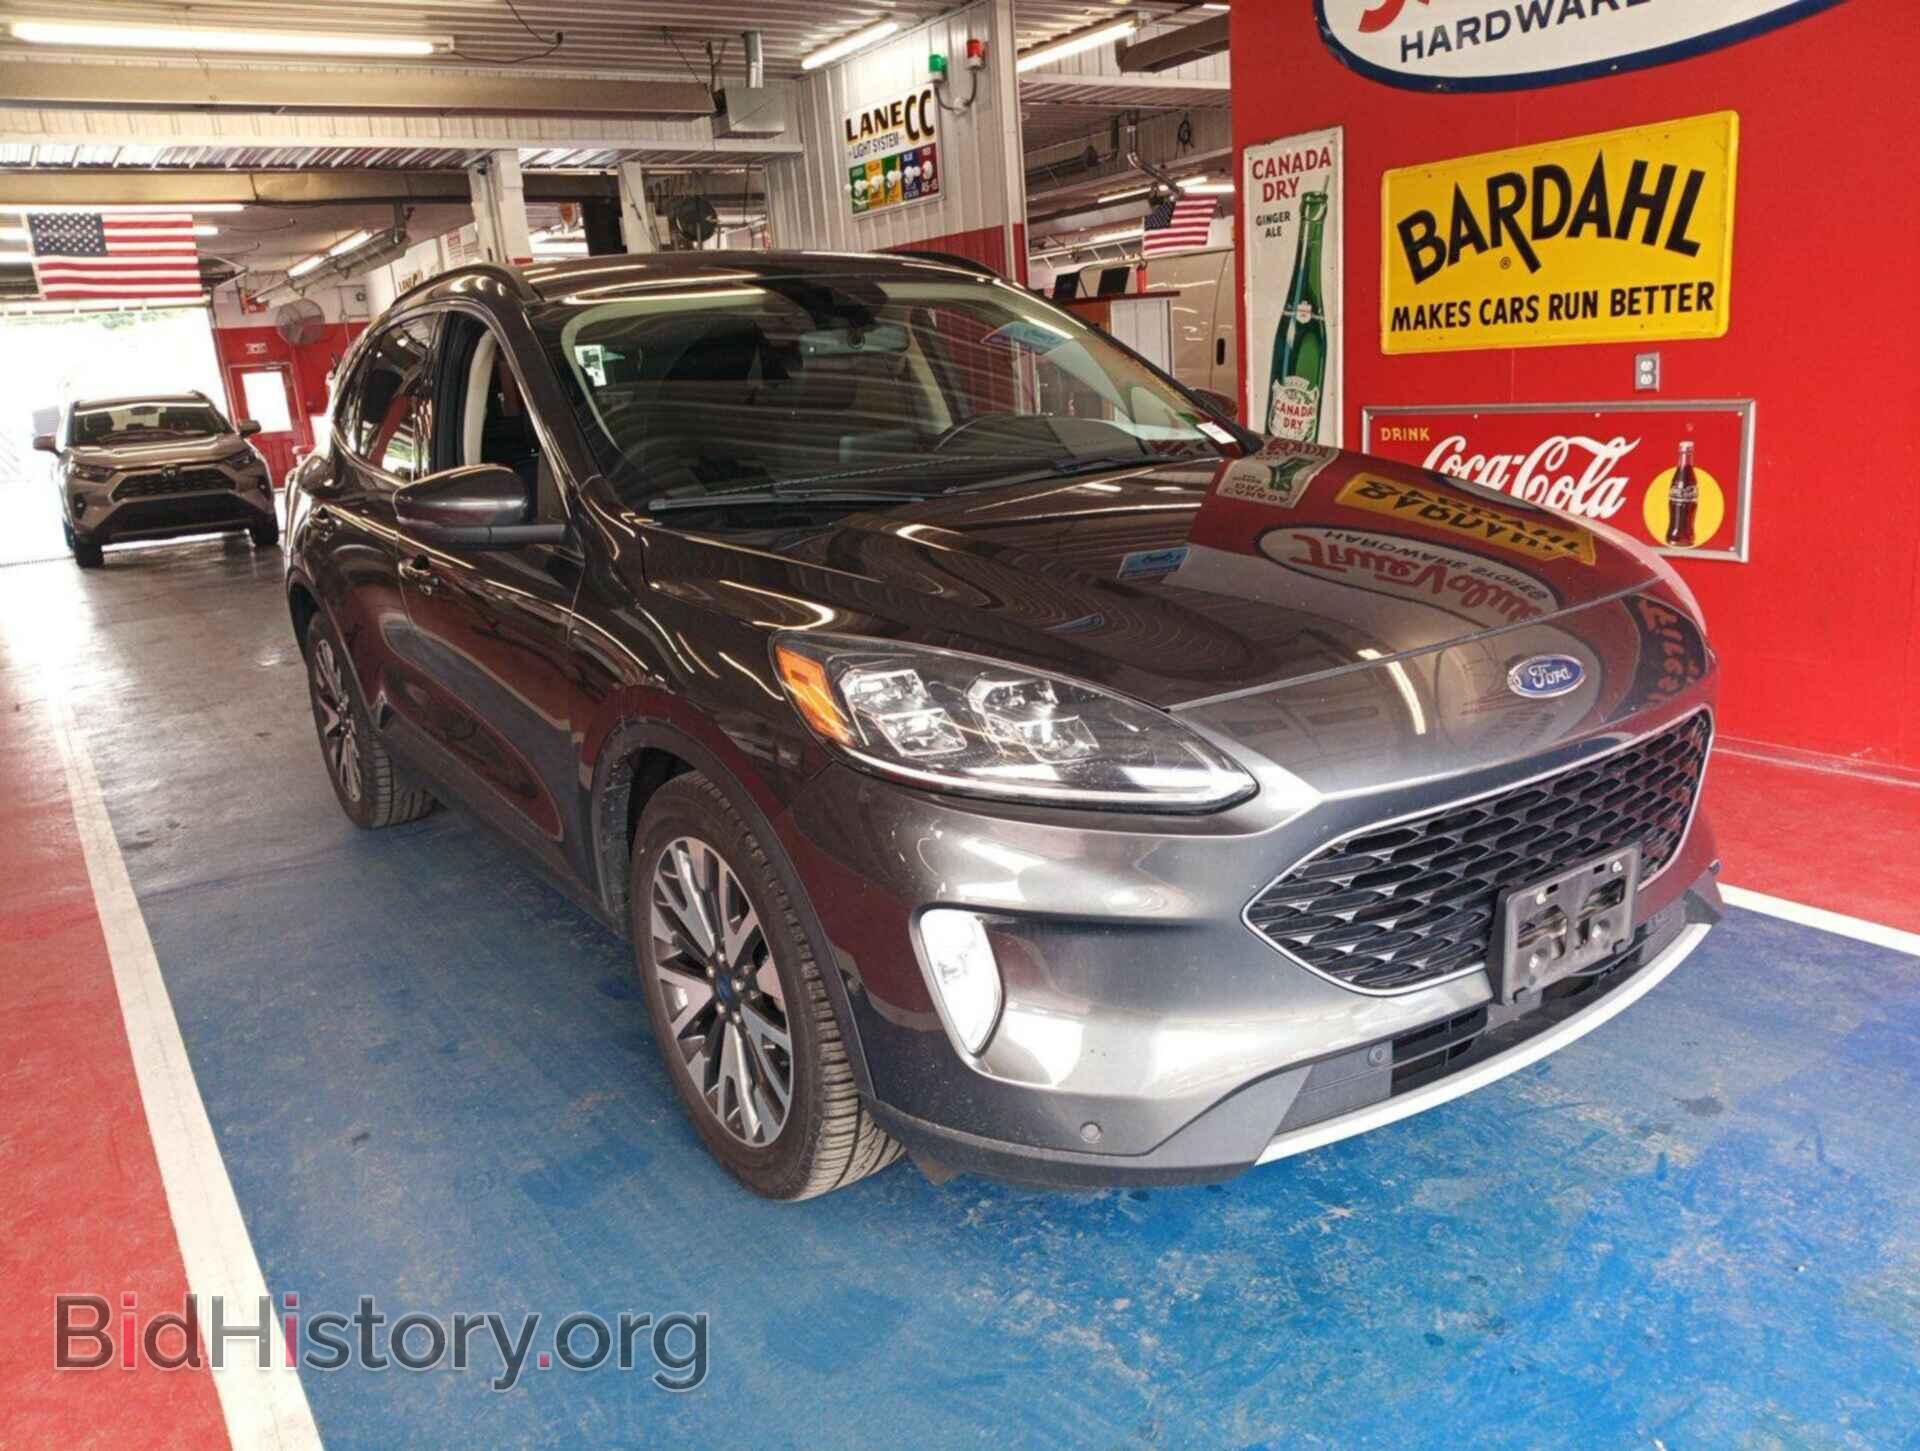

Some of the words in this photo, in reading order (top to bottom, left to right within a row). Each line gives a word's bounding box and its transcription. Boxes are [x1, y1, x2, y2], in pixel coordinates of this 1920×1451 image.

[1400, 0, 1652, 62] HARDWAR
[845, 101, 903, 141] LANE
[904, 89, 935, 141] CC
[1251, 146, 1332, 180] CANADA
[1262, 176, 1300, 203] DRY
[1256, 211, 1291, 227] GINGER
[1396, 148, 1706, 286] BARDAHL
[1265, 226, 1282, 239] ALE
[1391, 300, 1472, 333] MAKES
[1479, 295, 1540, 327] CARS
[1548, 290, 1599, 321] RUN
[1610, 281, 1715, 318] BETTER
[1275, 399, 1313, 417] CANADA
[1282, 417, 1304, 430] DRY
[1380, 427, 1431, 442] DRINK
[1422, 434, 1642, 520] Coca-Cola
[1527, 663, 1573, 689] Ford
